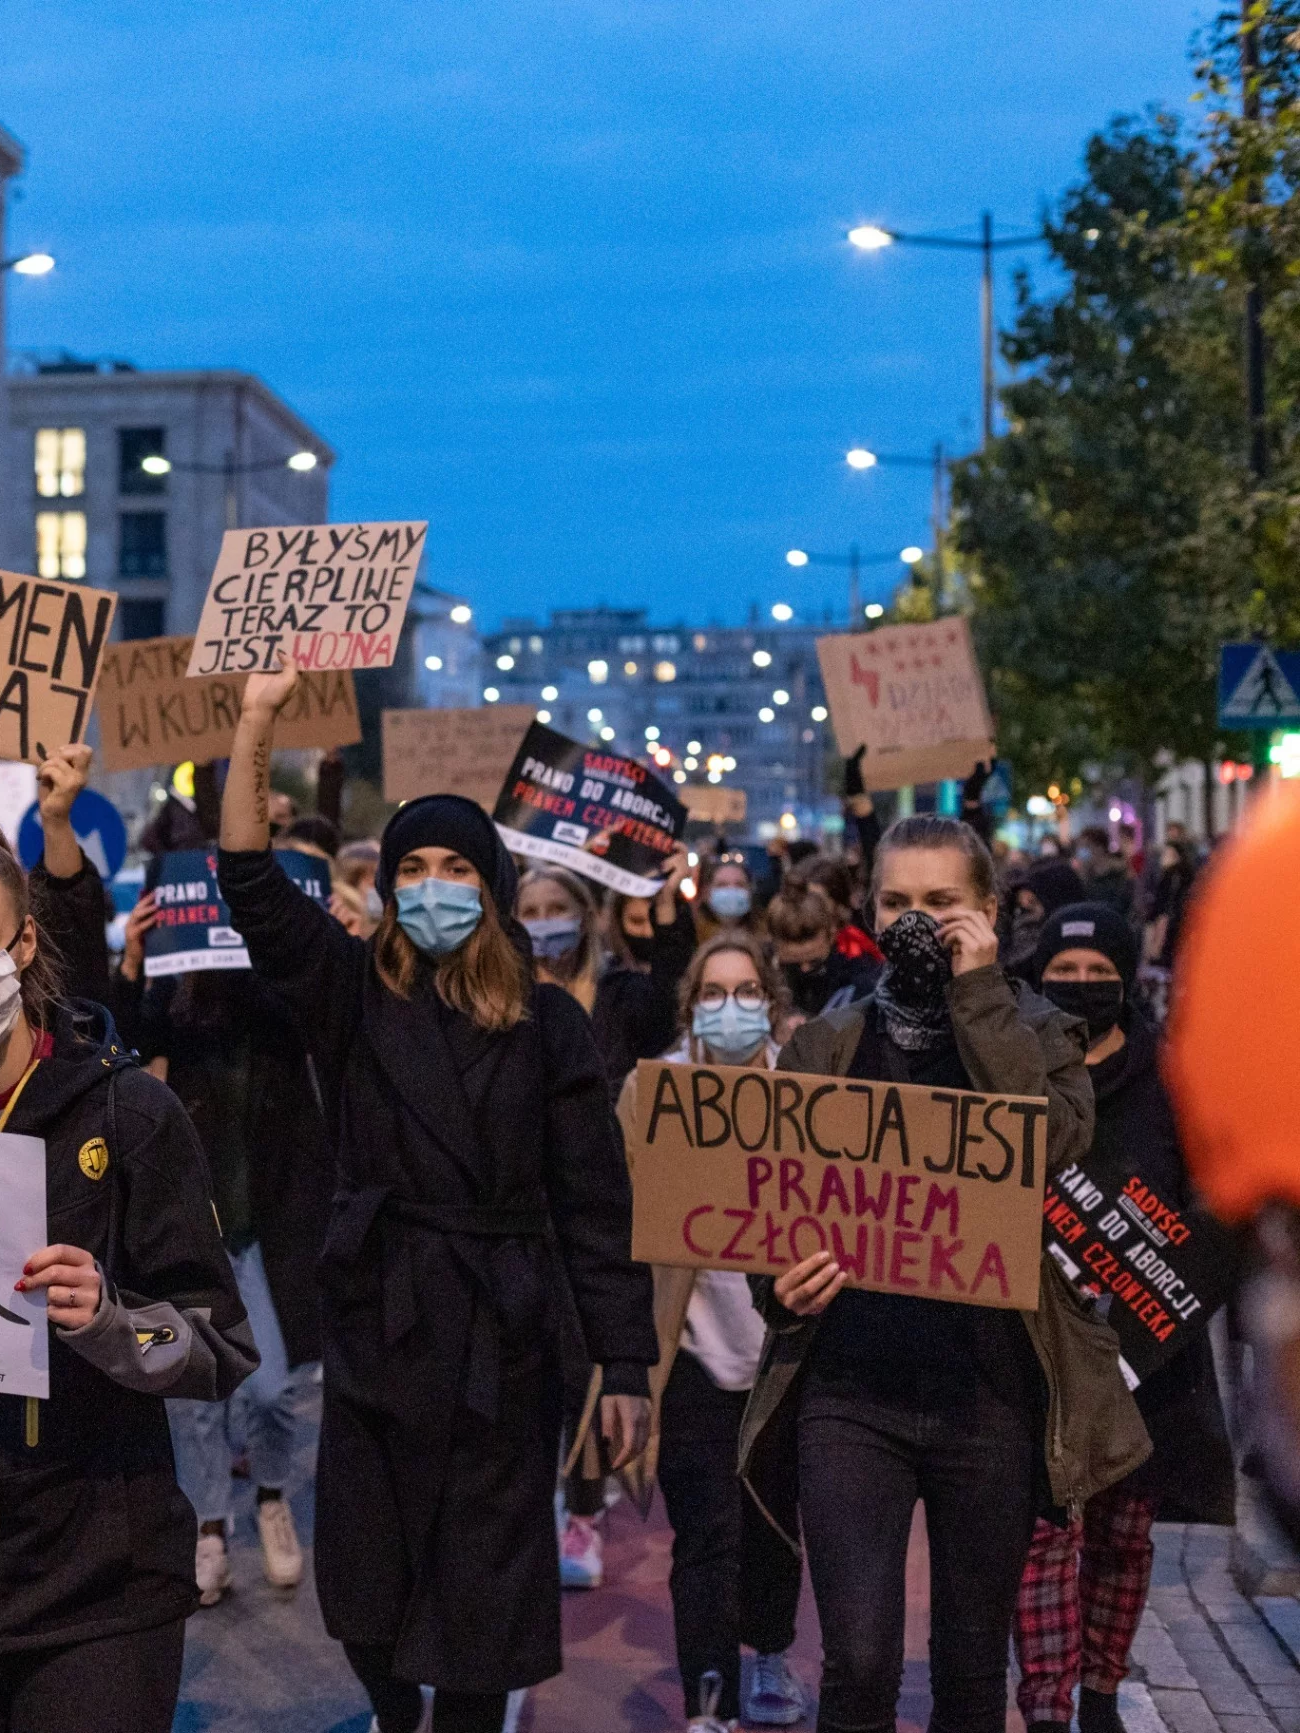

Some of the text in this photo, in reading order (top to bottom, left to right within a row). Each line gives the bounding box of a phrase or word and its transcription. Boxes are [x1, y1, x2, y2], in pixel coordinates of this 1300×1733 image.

[244, 524, 428, 569] BYŁYŚMY
[213, 567, 411, 604] CIERPLIWE
[221, 602, 391, 637] TERAZ TO
[199, 631, 392, 674] JEST WOJNA
[520, 756, 575, 794] PRAWO
[579, 778, 605, 802] DO
[153, 881, 208, 906] PRAWO
[154, 905, 220, 928] PRAWEM
[645, 1067, 1048, 1189] ABORCJA JEST
[746, 1156, 960, 1238] PRAWEM
[1122, 1176, 1192, 1247] SADYŚCI
[682, 1204, 1011, 1300] CZŁOWIEKA
[1097, 1209, 1131, 1242] DO
[1124, 1241, 1202, 1321] ABORCJI
[1082, 1242, 1177, 1344] CZŁOWIEKA
